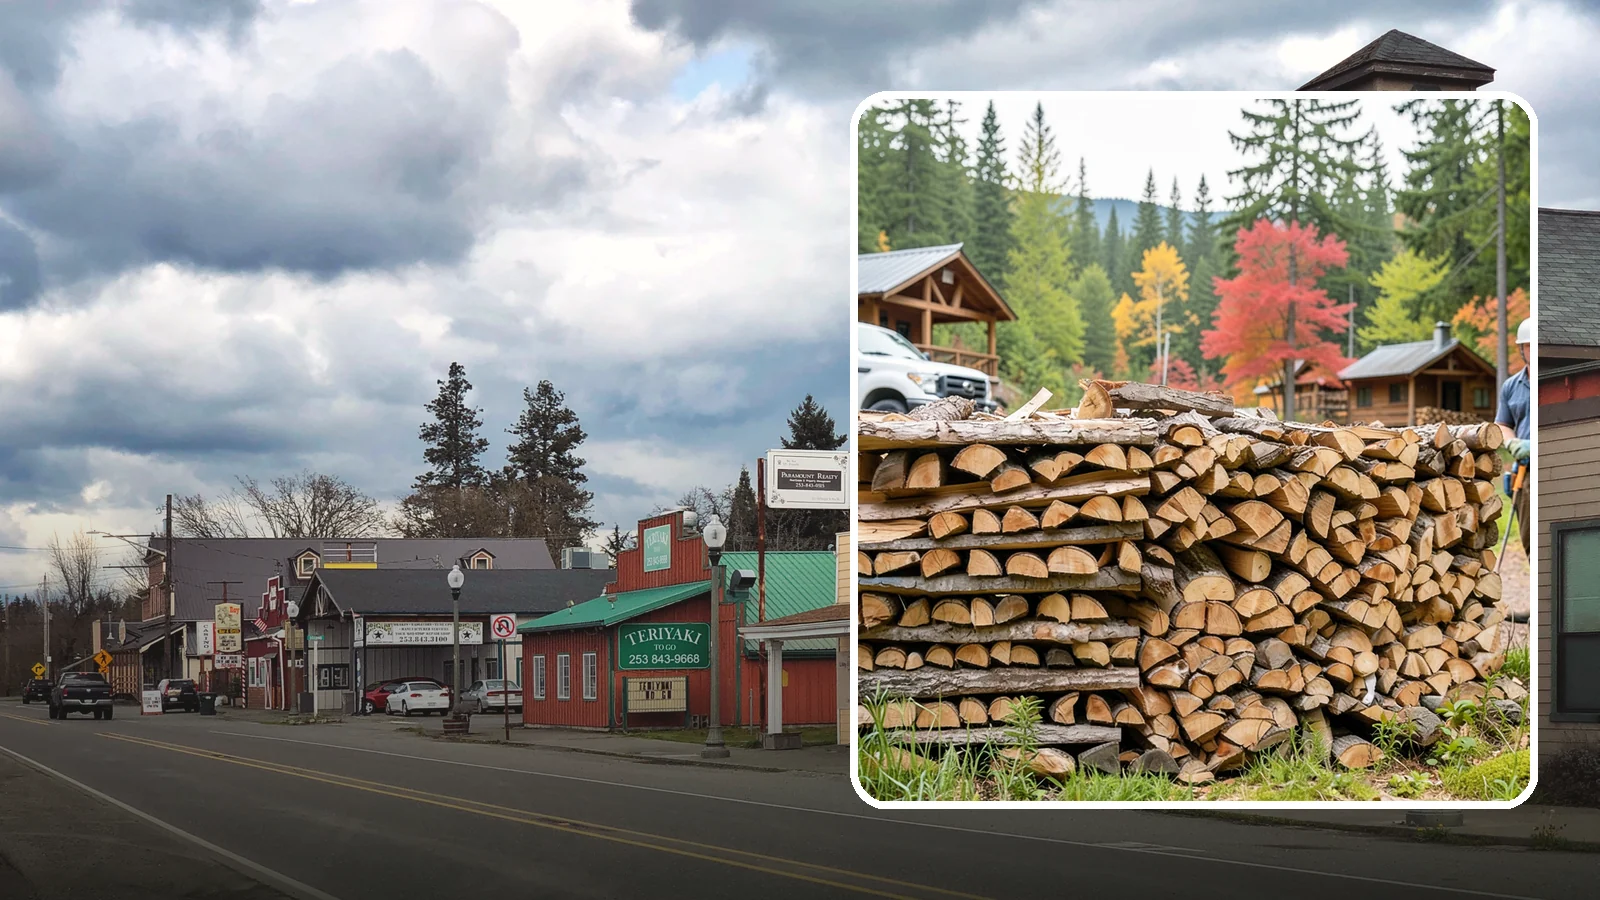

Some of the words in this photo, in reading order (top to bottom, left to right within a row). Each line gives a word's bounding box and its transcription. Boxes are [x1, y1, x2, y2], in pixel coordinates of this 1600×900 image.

[625, 627, 702, 646] TERIYAKI
[629, 654, 648, 664] 253
[651, 653, 700, 664] 843-9668
